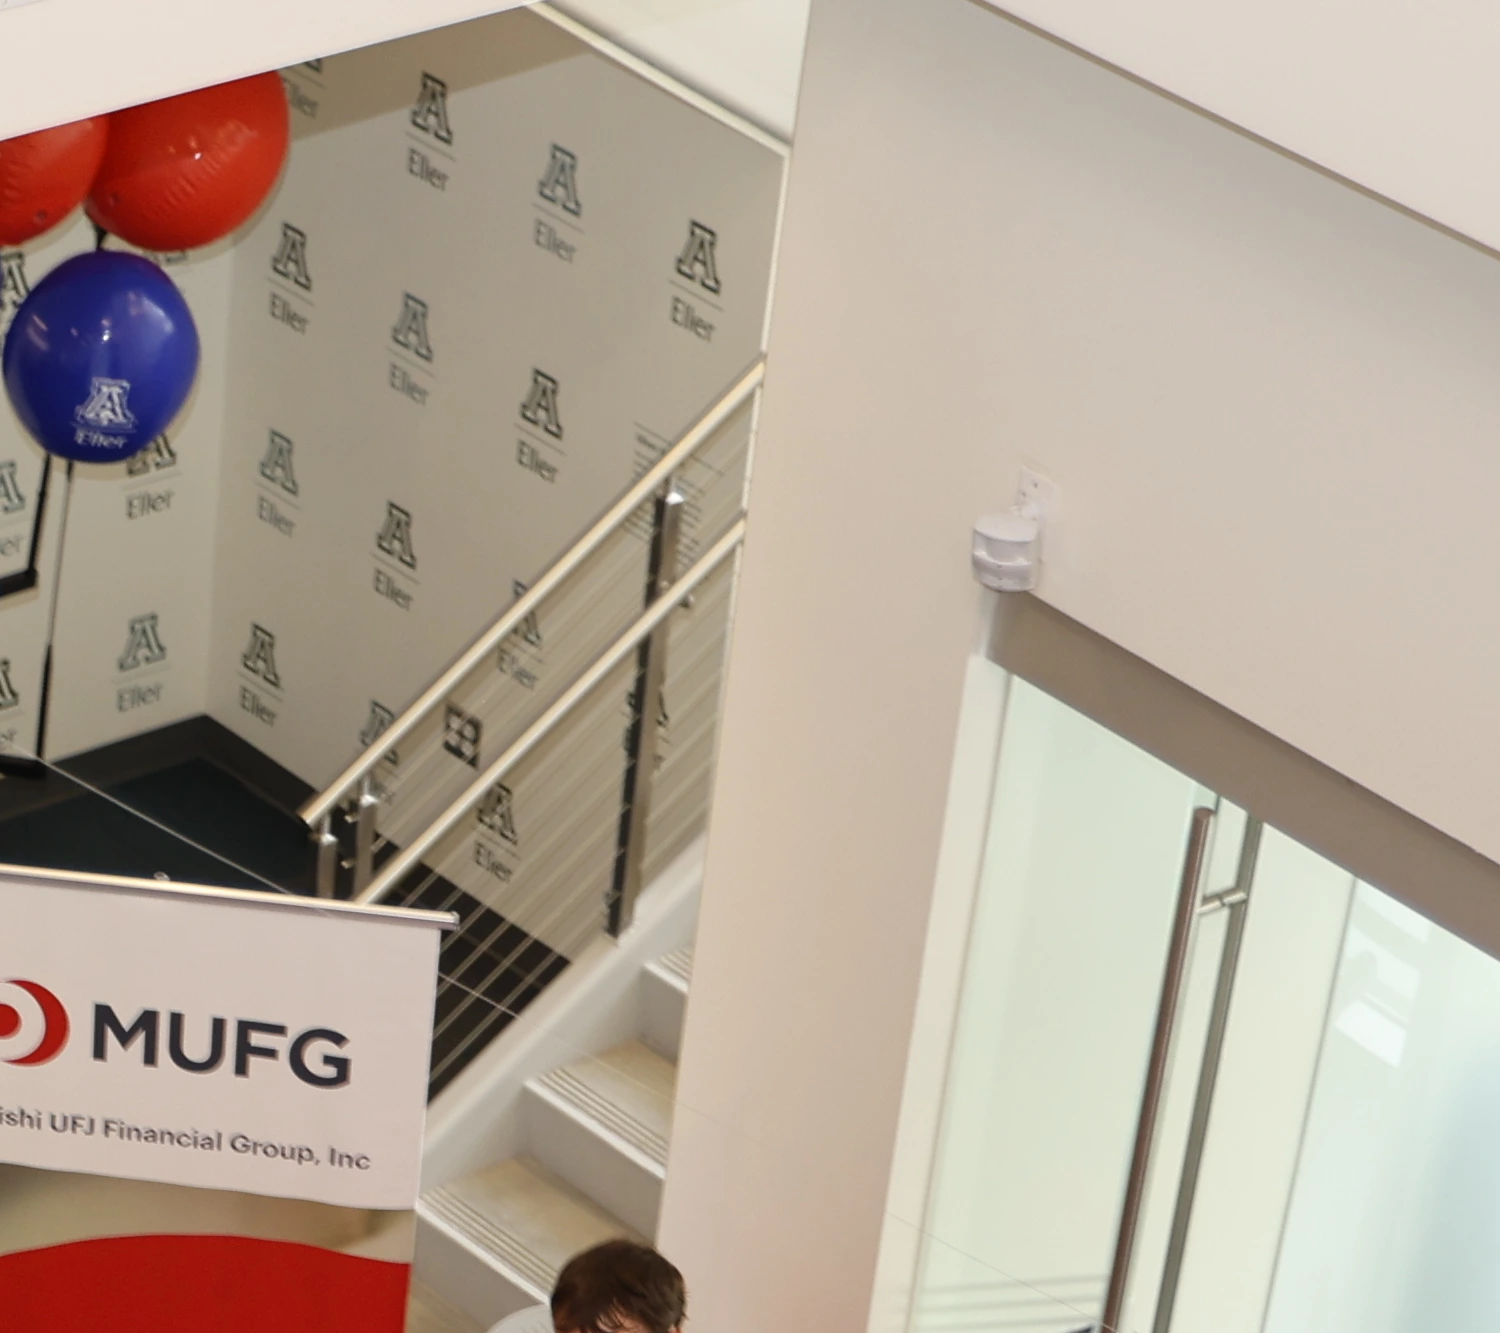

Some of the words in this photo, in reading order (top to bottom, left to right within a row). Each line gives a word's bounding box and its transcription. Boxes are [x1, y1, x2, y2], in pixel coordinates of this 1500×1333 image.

[408, 147, 449, 193] Eller
[533, 218, 579, 264] Eller
[267, 292, 310, 336] Eller
[670, 296, 717, 343] Eller
[387, 362, 430, 406] Eller
[515, 440, 560, 484] Eller
[126, 490, 175, 520] Eller
[256, 497, 297, 539] Eller
[373, 567, 413, 611] Eller
[116, 683, 163, 713] Eller
[239, 690, 276, 728] Eller
[473, 840, 513, 884] Eller
[92, 1002, 352, 1090] MUFG
[50, 1112, 95, 1137] UFJ
[103, 1119, 223, 1152] Financial
[230, 1134, 321, 1168] Group,
[328, 1147, 372, 1172] Inc
